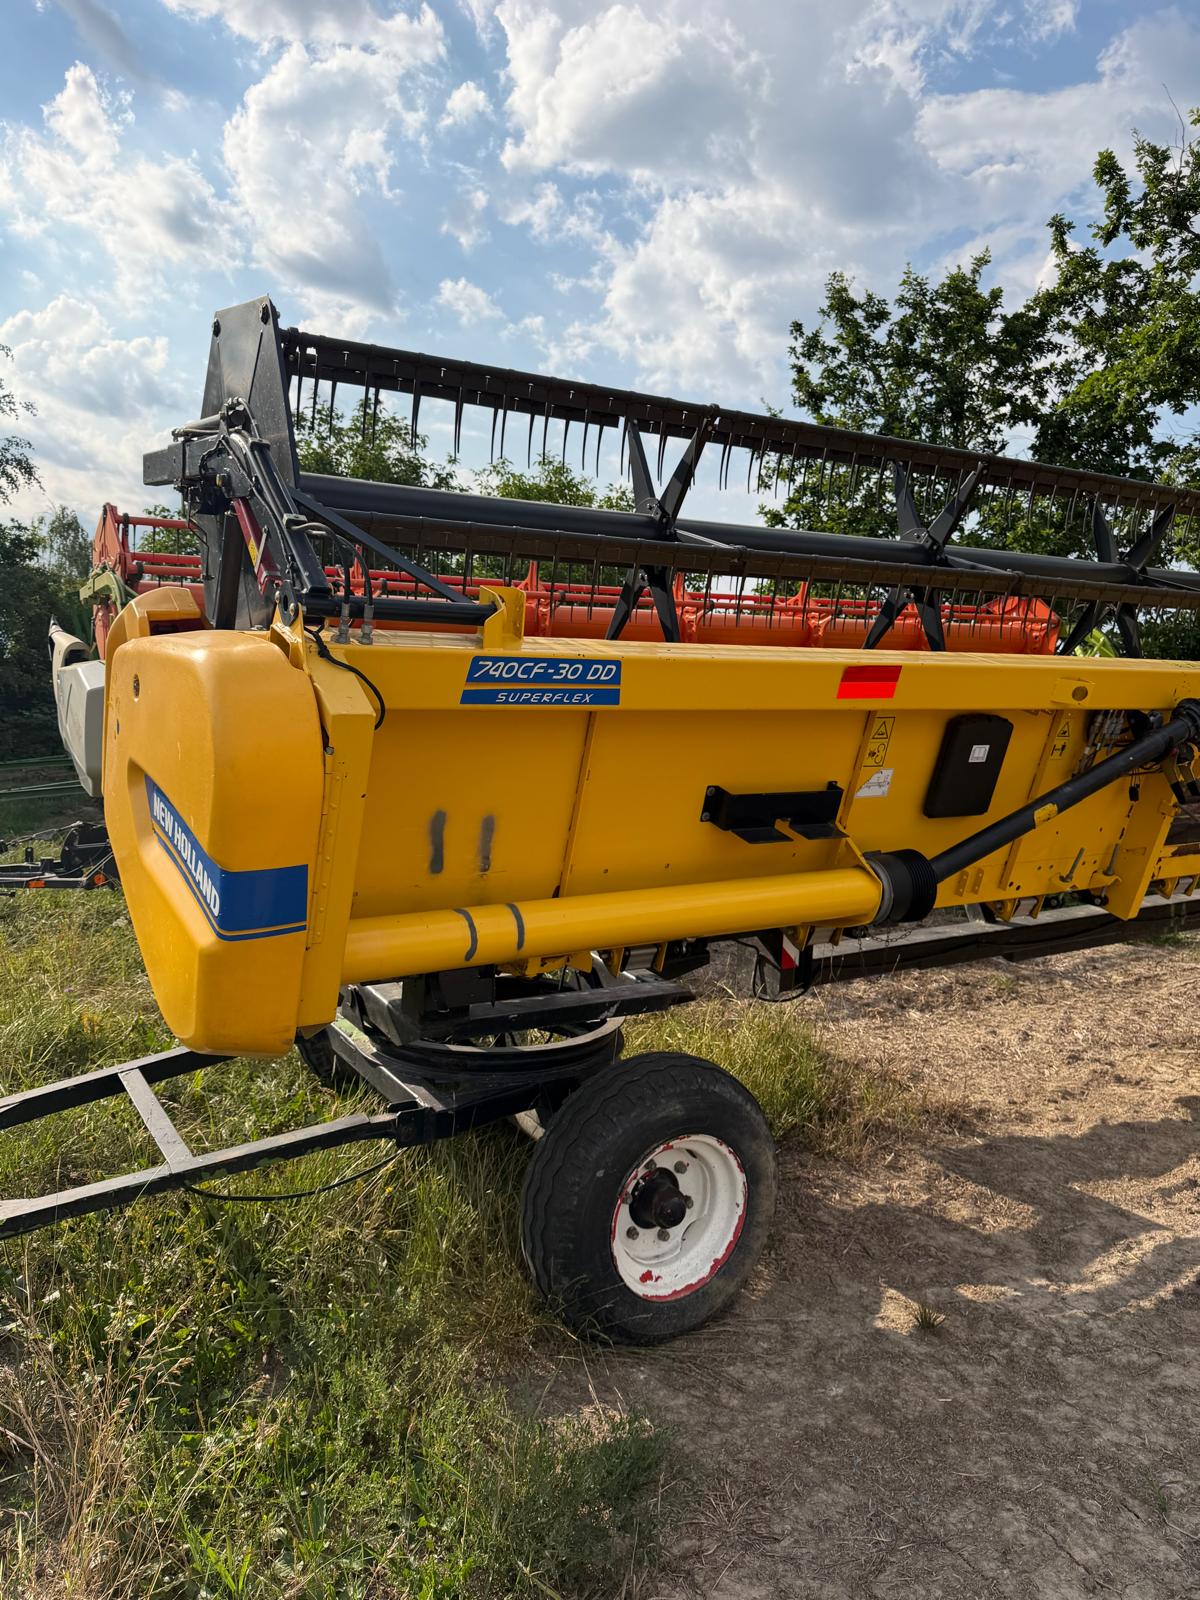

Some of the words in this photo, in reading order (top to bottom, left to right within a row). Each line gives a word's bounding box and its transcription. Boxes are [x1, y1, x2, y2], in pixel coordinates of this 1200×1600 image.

[474, 661, 583, 680] 740CF-30
[586, 665, 617, 680] DD
[495, 692, 595, 703] SUPERFLEX
[153, 793, 174, 837] NEW
[174, 821, 221, 917] HOLLAND
